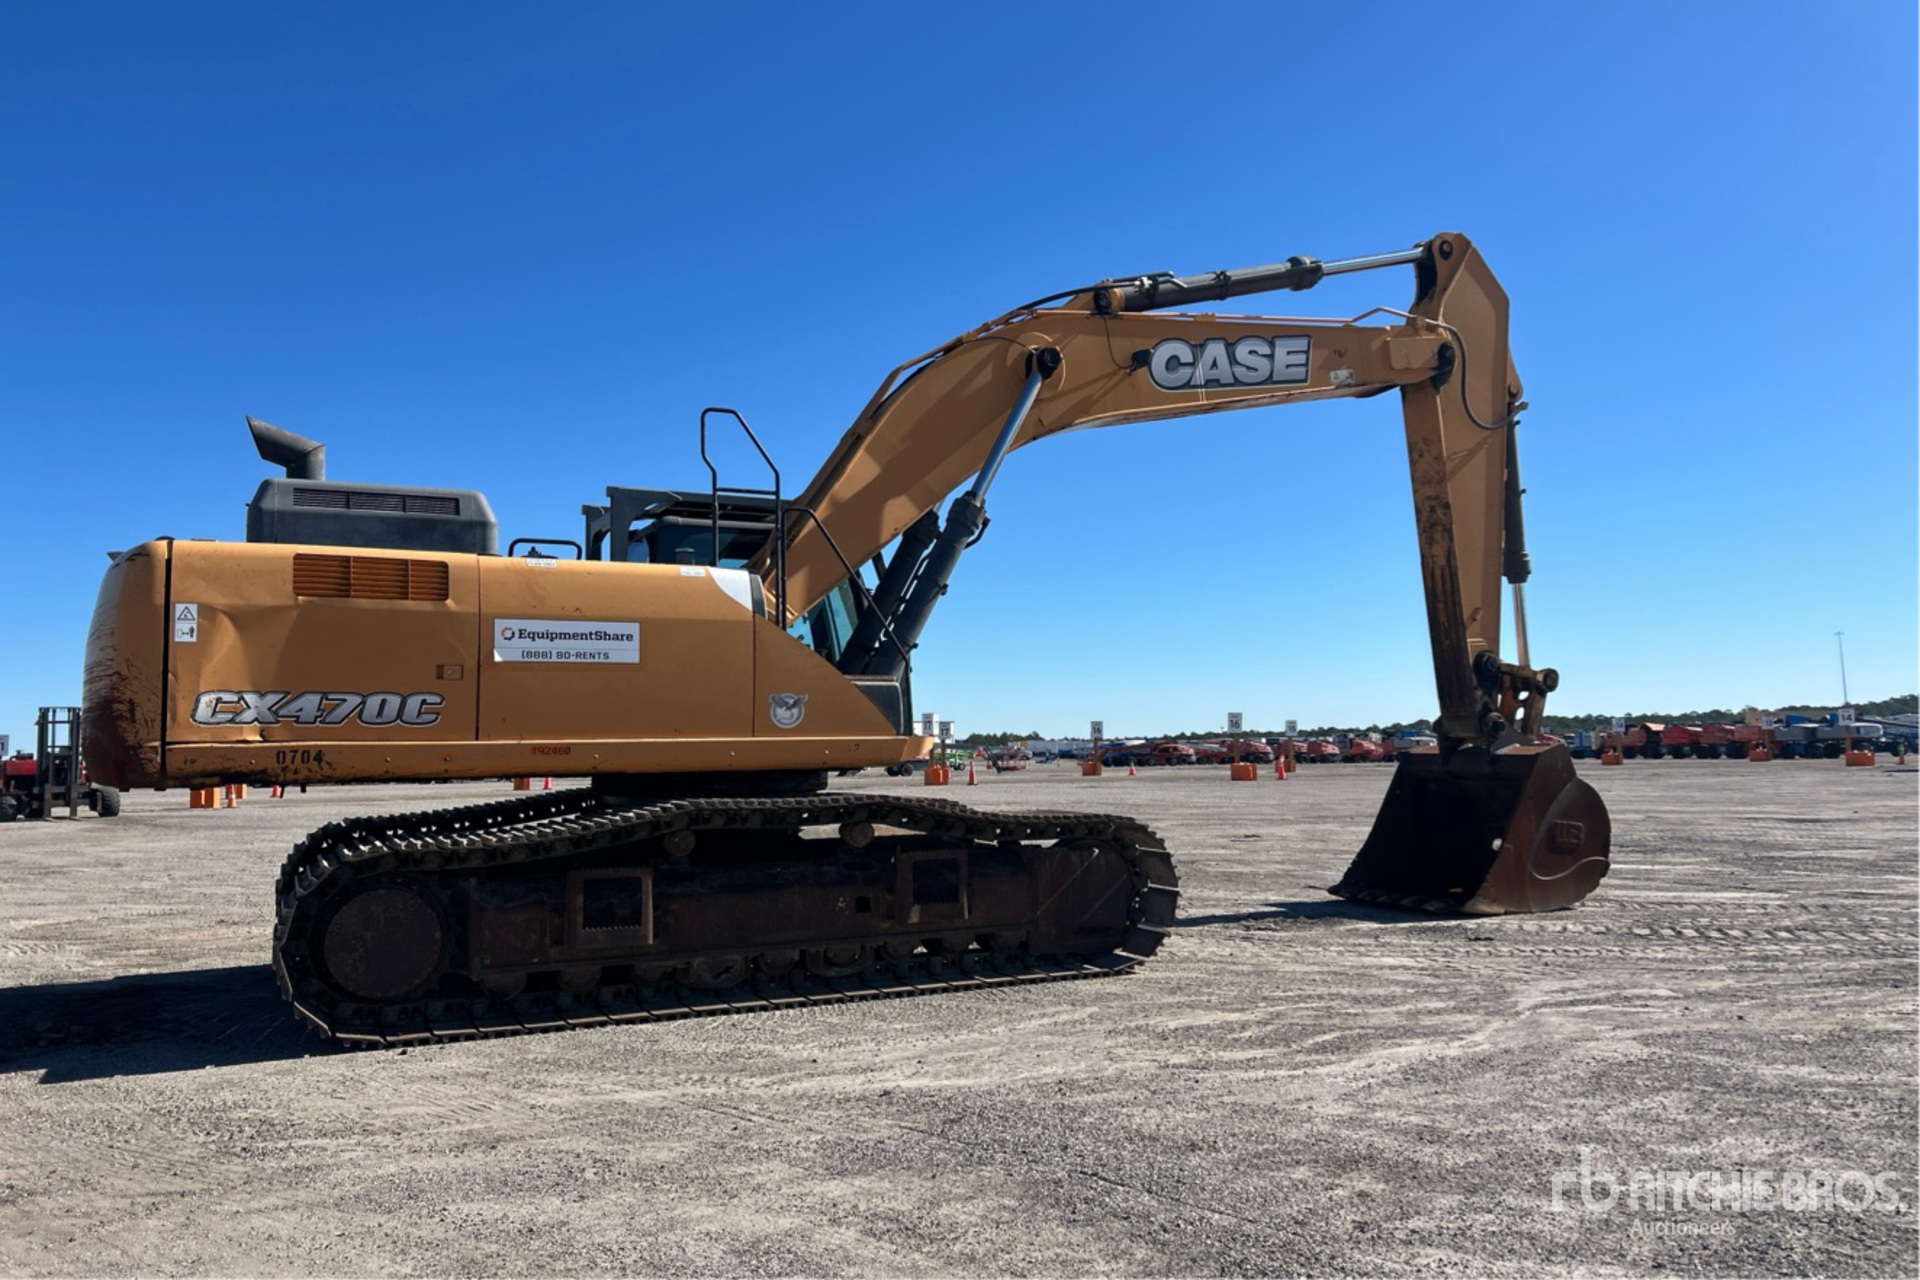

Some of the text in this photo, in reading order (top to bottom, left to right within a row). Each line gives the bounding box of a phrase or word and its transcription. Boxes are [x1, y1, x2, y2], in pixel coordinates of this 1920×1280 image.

[1149, 336, 1311, 391] CASE
[518, 629, 634, 642] EquipmentShare
[521, 650, 552, 660] (888)
[191, 691, 445, 727] CX470C
[1230, 719, 1240, 729] 16
[276, 749, 323, 765] 0704
